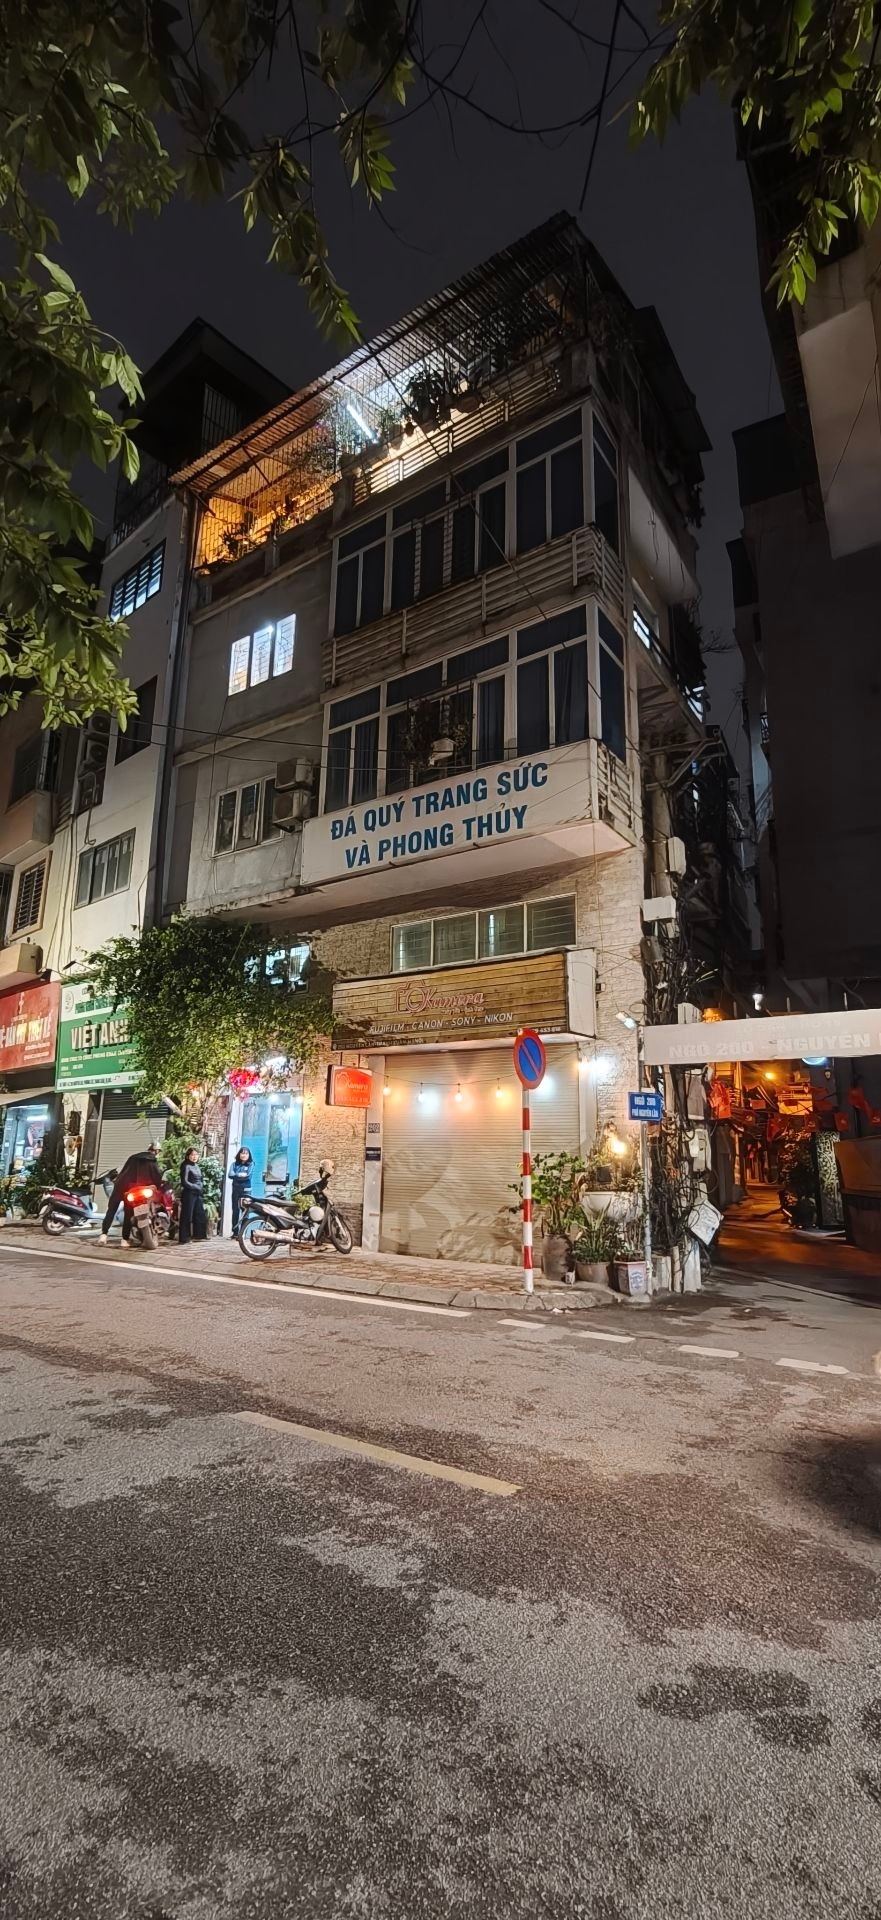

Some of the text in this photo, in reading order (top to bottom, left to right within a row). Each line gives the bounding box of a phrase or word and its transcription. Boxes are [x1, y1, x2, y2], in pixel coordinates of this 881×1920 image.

[331, 761, 548, 840] ĐÁ QUÝ TRANG SỨC
[345, 802, 528, 869] VÀ PHONG THỦY
[71, 1019, 98, 1053] VIỆT
[369, 1012, 513, 1034] FUJIFILM CANON SONY NIKON
